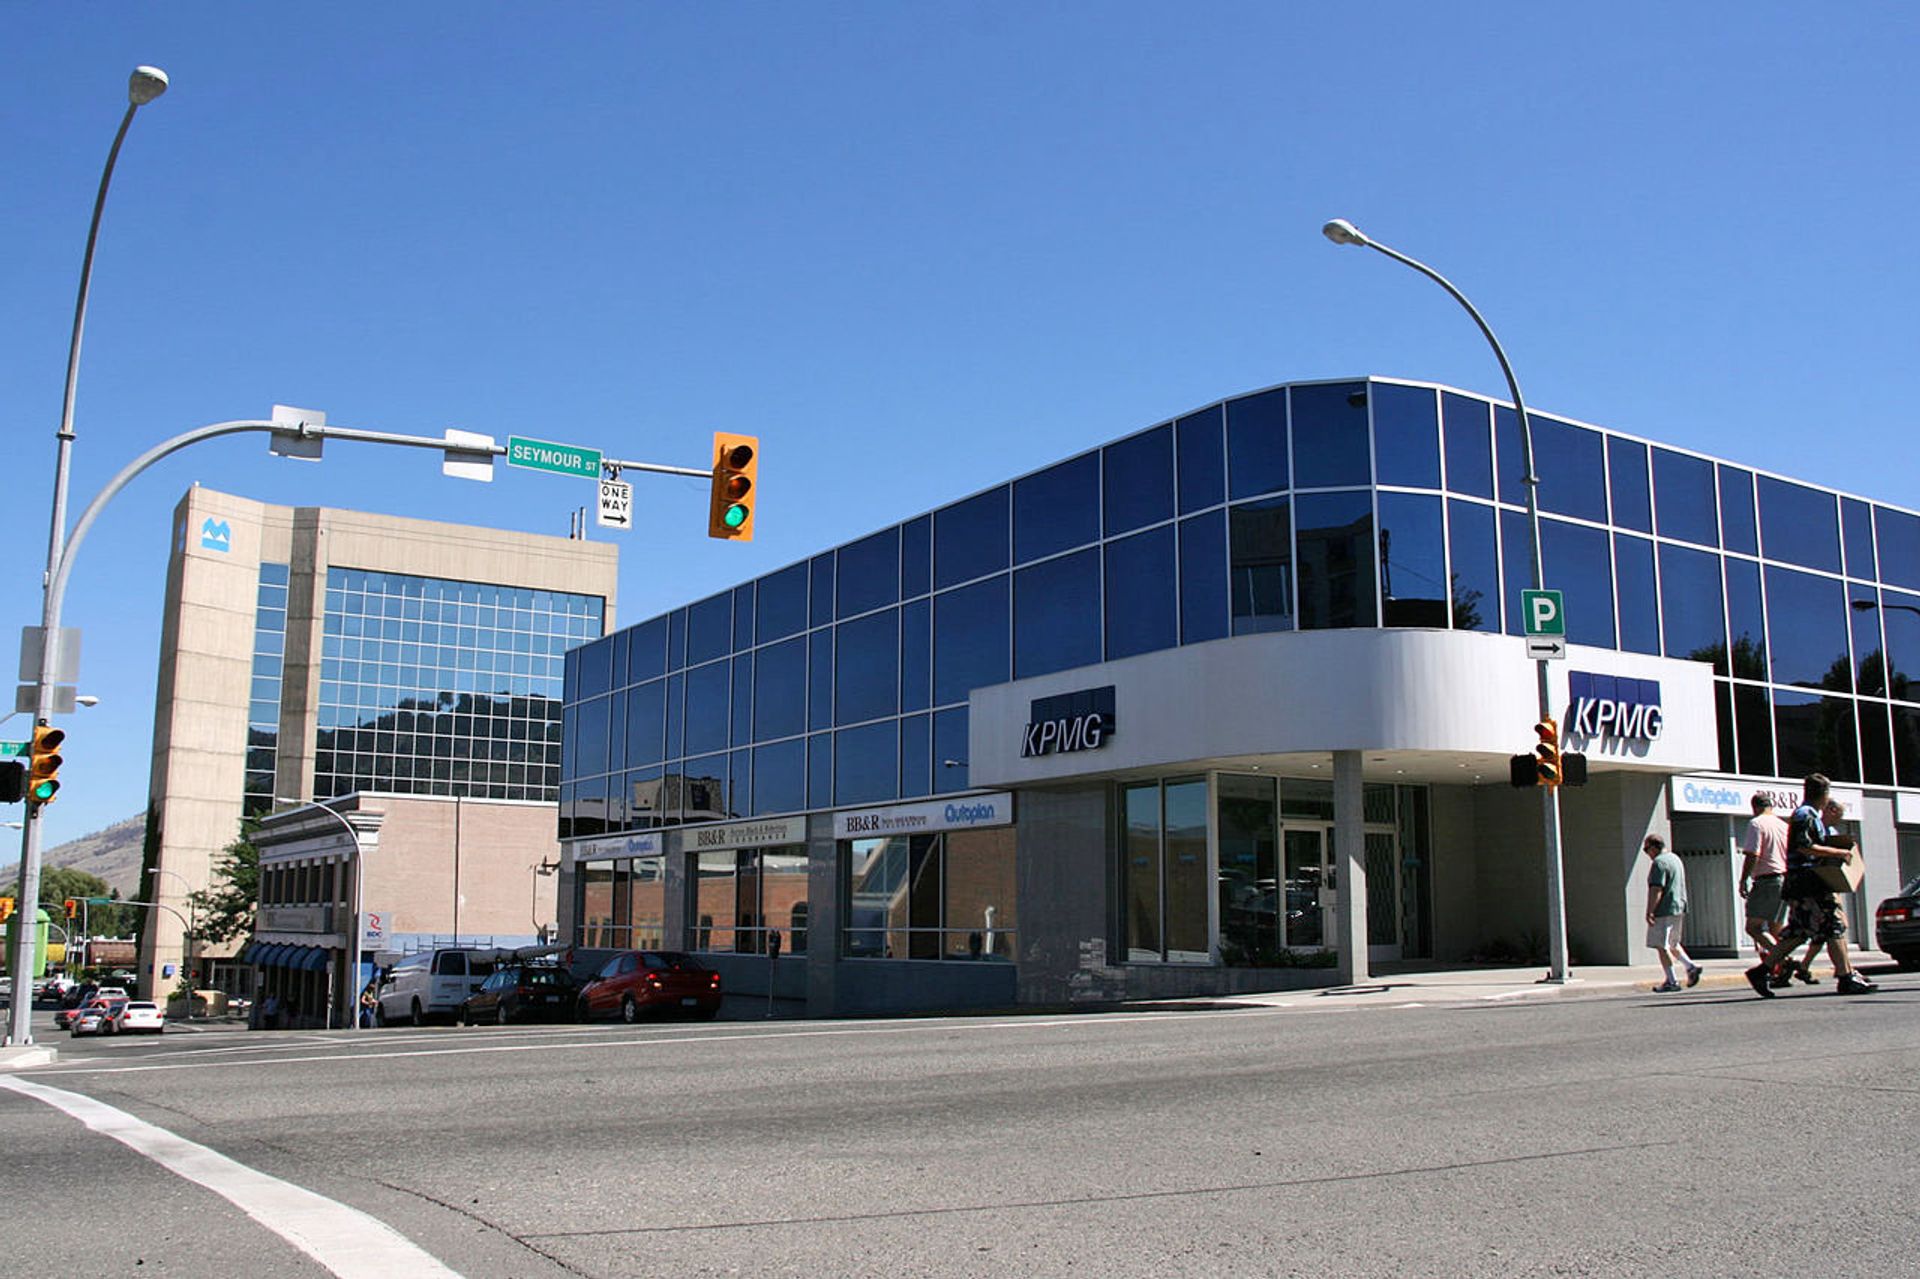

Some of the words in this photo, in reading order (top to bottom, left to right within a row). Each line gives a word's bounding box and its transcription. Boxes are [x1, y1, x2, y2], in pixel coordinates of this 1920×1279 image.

[513, 445, 582, 469] SEYMOUR
[585, 461, 597, 471] ST
[601, 486, 629, 499] ONE
[601, 499, 628, 511] WAY
[1532, 597, 1557, 632] P
[1573, 697, 1663, 741] KPMG
[1021, 713, 1102, 757] KPMG
[846, 814, 880, 832] BB&R
[697, 829, 726, 847] BB&R
